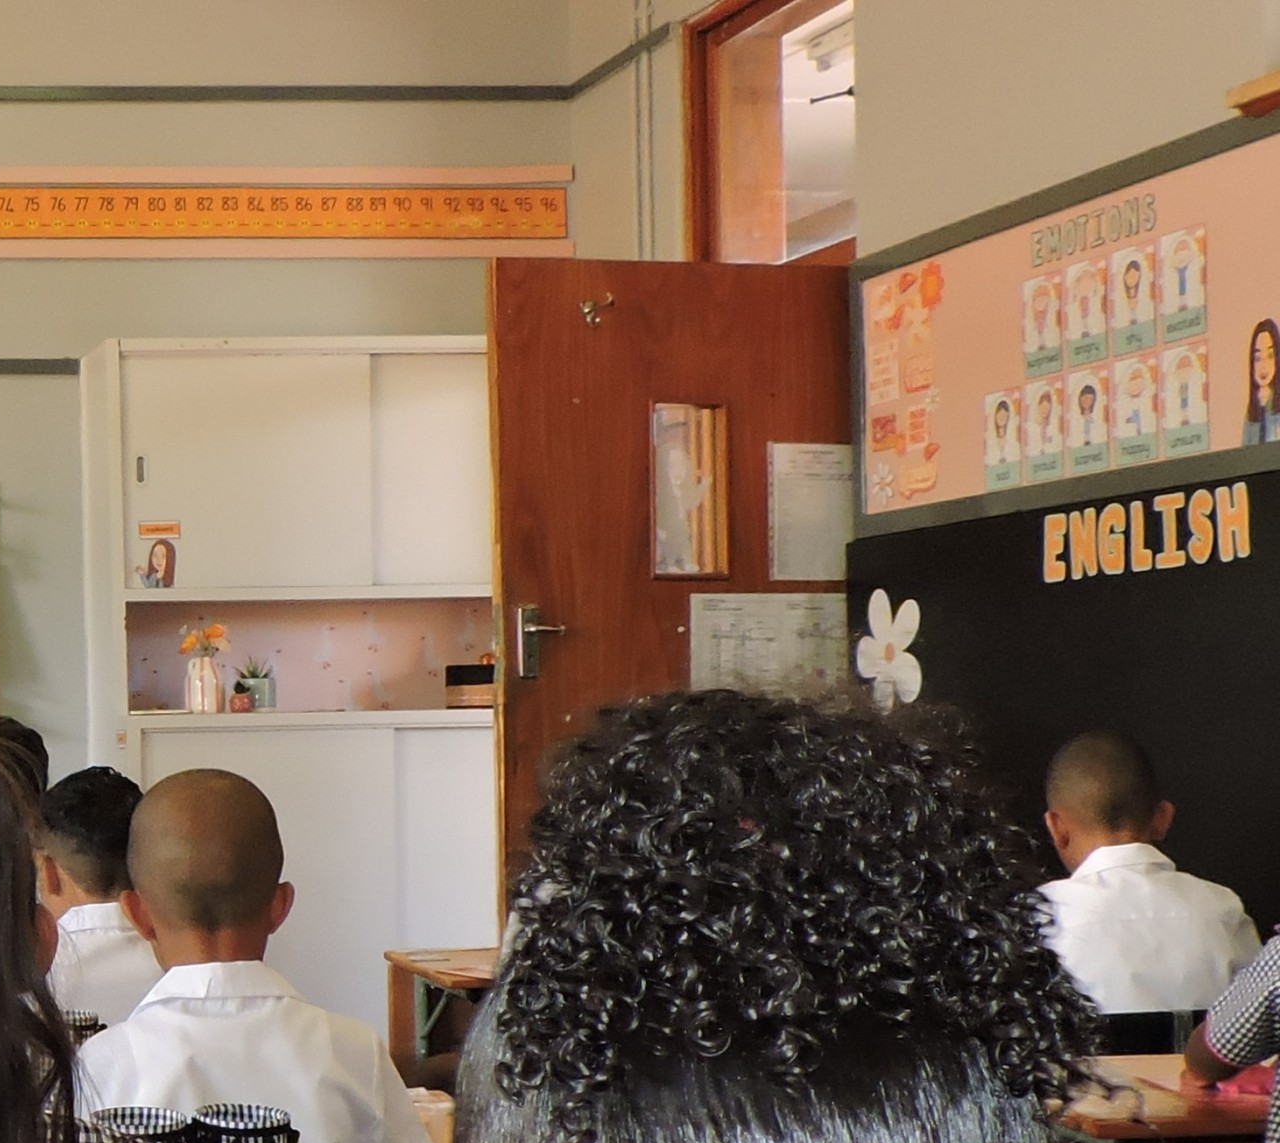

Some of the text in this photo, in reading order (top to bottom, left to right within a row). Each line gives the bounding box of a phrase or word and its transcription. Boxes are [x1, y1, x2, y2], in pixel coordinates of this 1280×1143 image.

[0, 197, 14, 212] 74
[24, 197, 40, 211] 75
[51, 197, 66, 212] 76
[75, 197, 89, 211] 77
[99, 197, 114, 211] 78
[123, 197, 138, 210] 79
[148, 197, 166, 211] 80
[175, 197, 186, 211] 81
[197, 197, 213, 211] 82
[222, 197, 238, 211] 83
[248, 197, 264, 212] 84
[271, 197, 288, 211] 85
[296, 197, 312, 211] 86
[321, 197, 337, 211] 87
[346, 197, 363, 211] 88
[370, 197, 386, 211] 89
[393, 197, 411, 212] 90
[421, 197, 432, 210] 91
[444, 198, 460, 212] 92
[467, 198, 484, 211] 93
[491, 197, 508, 212] 94
[514, 197, 532, 212] 95
[540, 198, 557, 212] 96
[1031, 193, 1157, 268] EMOTIONS
[1043, 481, 1251, 583] ENGLISH
